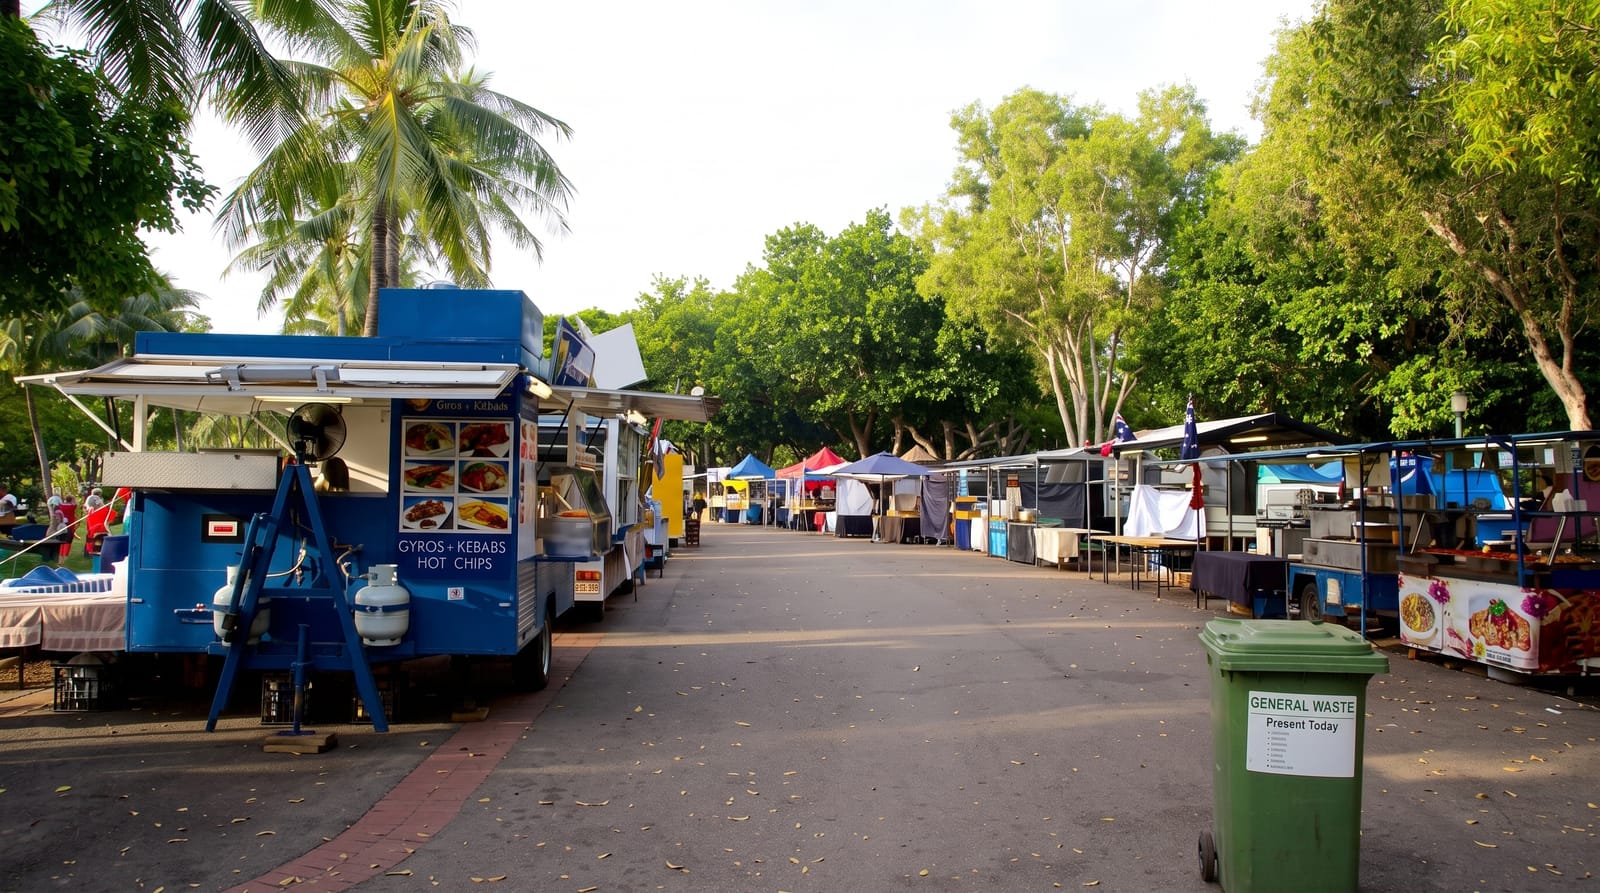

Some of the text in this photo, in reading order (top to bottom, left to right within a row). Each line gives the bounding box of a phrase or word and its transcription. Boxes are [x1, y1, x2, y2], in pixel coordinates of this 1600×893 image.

[398, 540, 444, 553] GYROS
[457, 541, 506, 554] KEBABS
[418, 557, 493, 570] HOT CHIPS
[1250, 696, 1355, 713] GENERAL WASTE
[1266, 717, 1339, 733] Present Today
